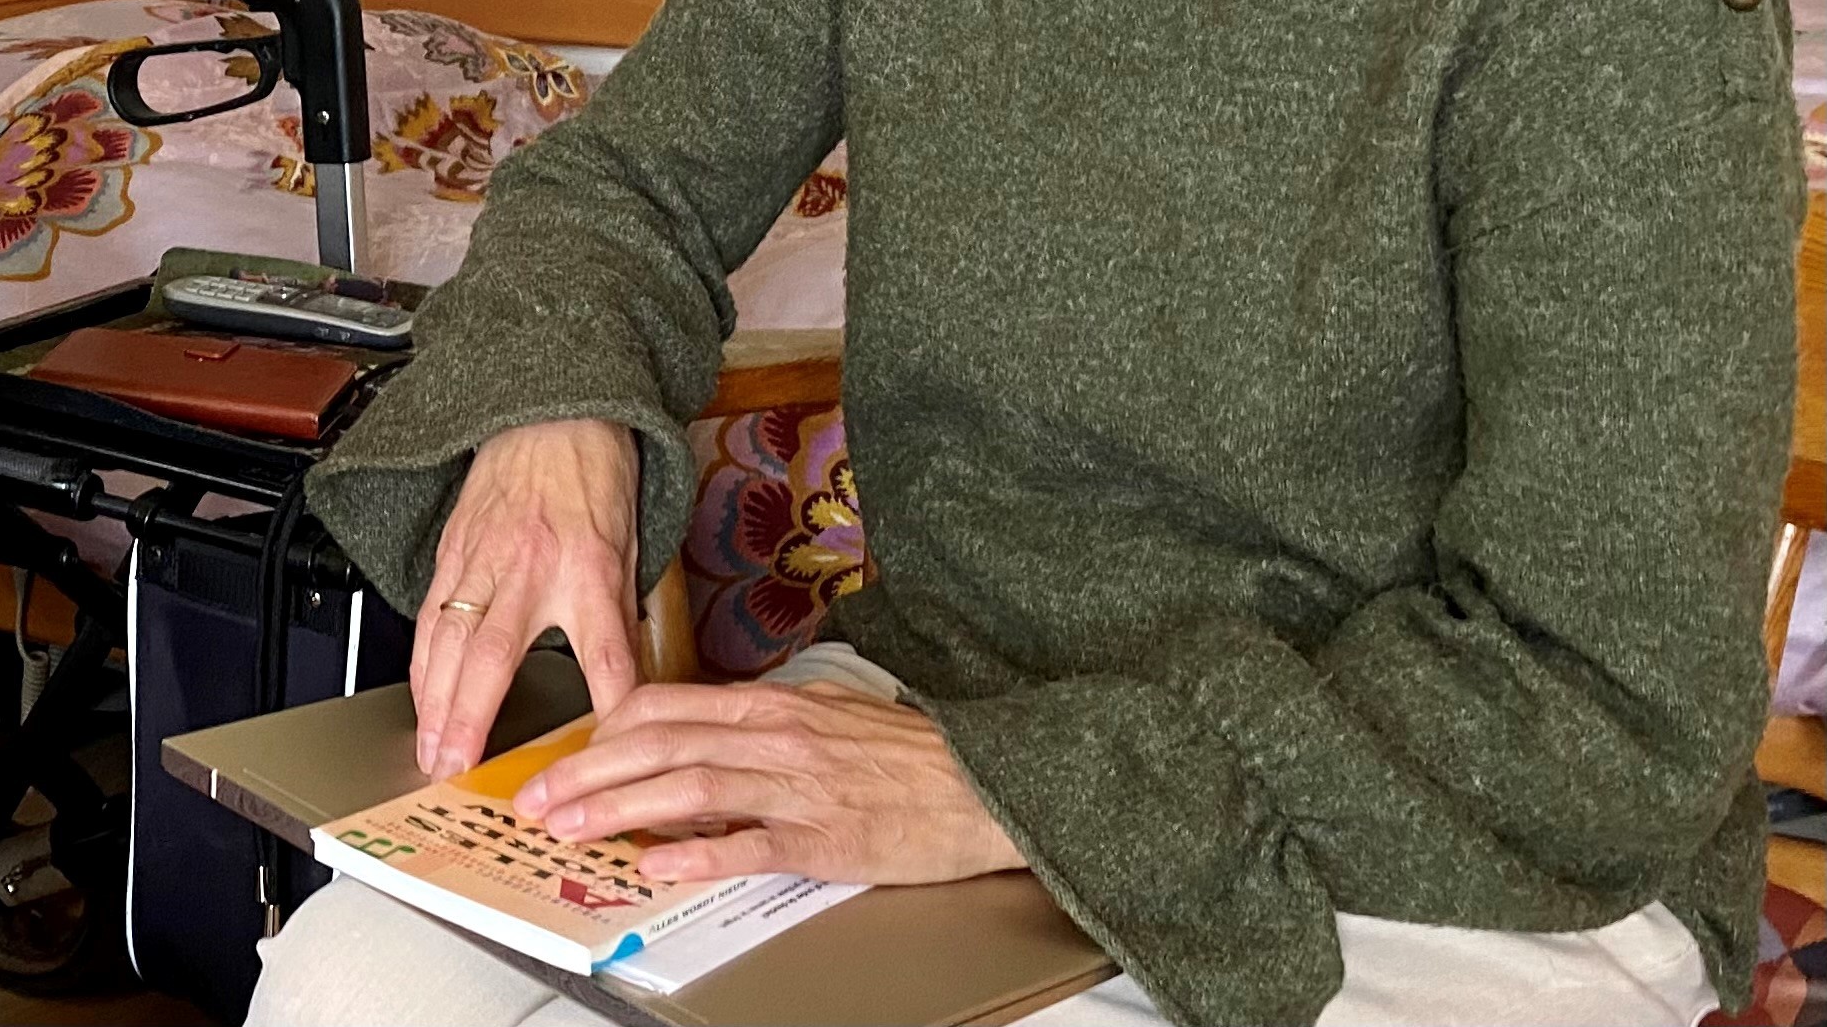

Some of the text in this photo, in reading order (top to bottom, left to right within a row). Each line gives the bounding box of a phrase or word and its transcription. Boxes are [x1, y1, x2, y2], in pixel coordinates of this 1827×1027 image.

[404, 814, 642, 909] ALLES
[417, 802, 653, 900] WORDT
[463, 803, 677, 886] IEUW
